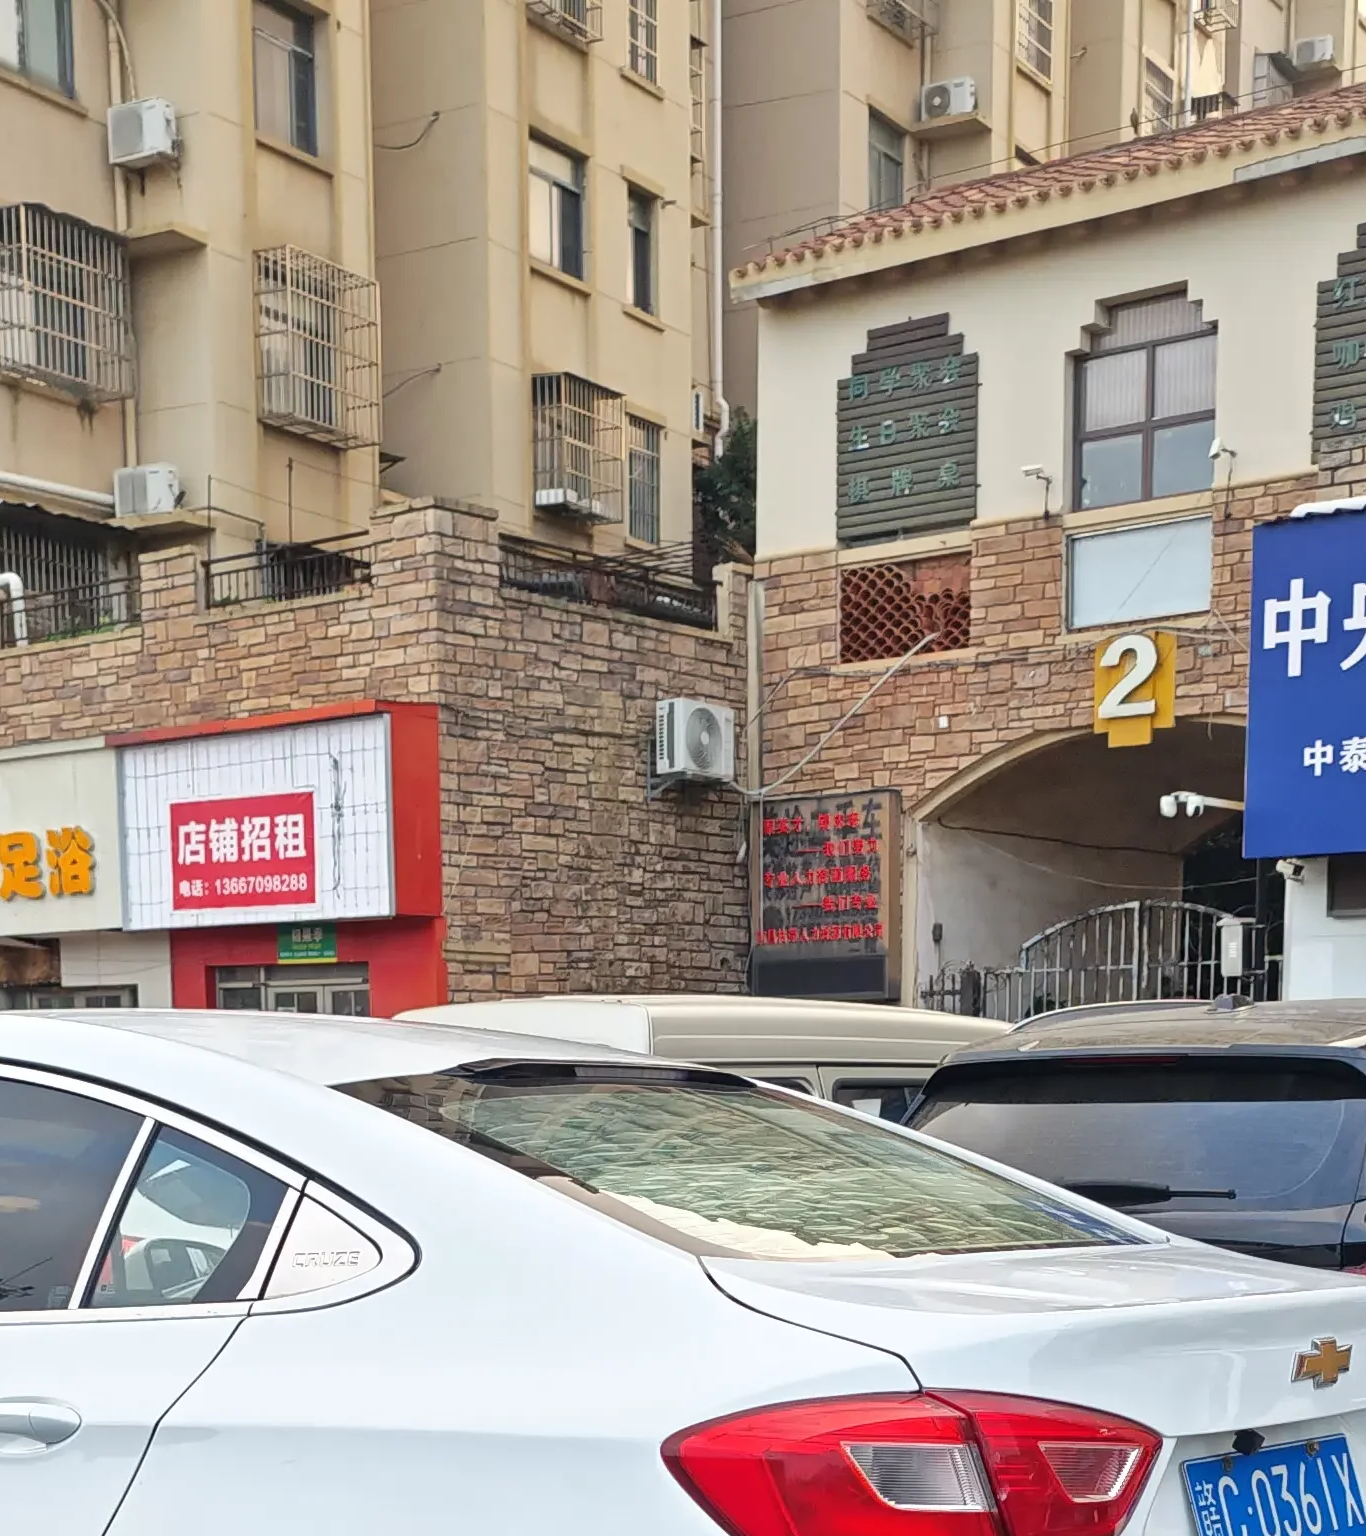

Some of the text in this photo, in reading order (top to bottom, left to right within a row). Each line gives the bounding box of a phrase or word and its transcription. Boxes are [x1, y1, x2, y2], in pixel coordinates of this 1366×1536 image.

[849, 357, 962, 401] 同学聚会
[849, 406, 961, 451] 生日聚会
[848, 460, 961, 504] 棋牌桌
[1098, 634, 1158, 719] 2
[178, 813, 307, 866] 店铺招租
[291, 1251, 360, 1268] CRUZE
